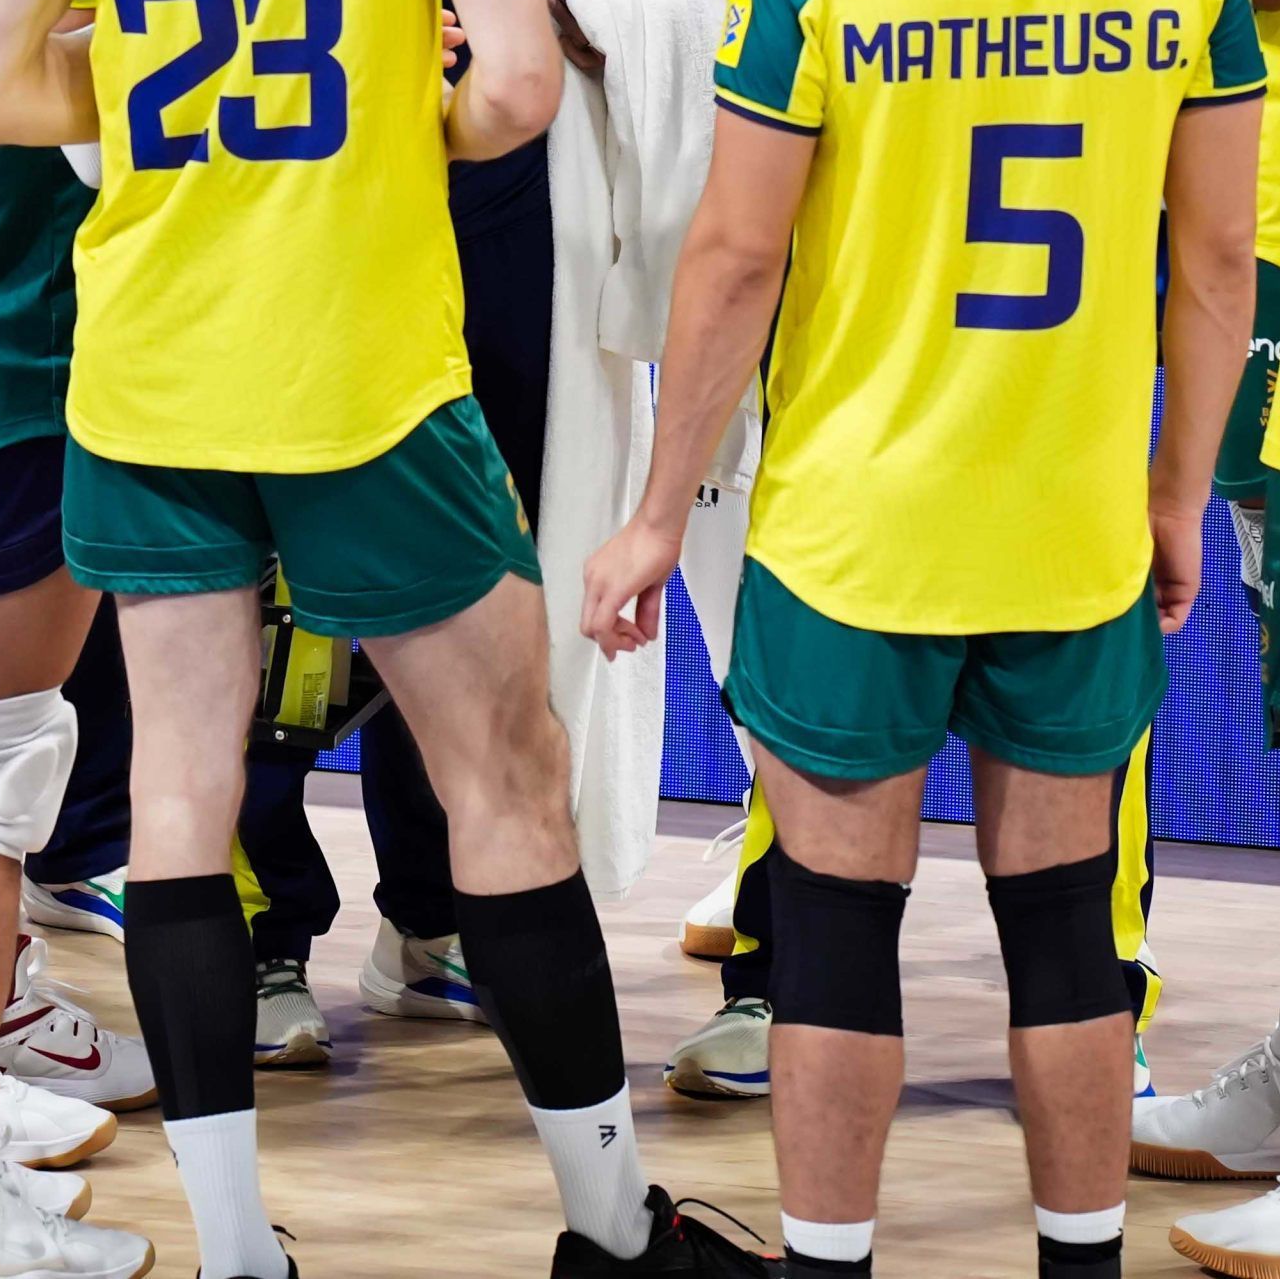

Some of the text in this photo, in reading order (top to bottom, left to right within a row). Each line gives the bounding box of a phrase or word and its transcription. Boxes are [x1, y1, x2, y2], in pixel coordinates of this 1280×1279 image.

[842, 9, 1189, 84] MATHEUS G.
[955, 122, 1085, 332] 5
